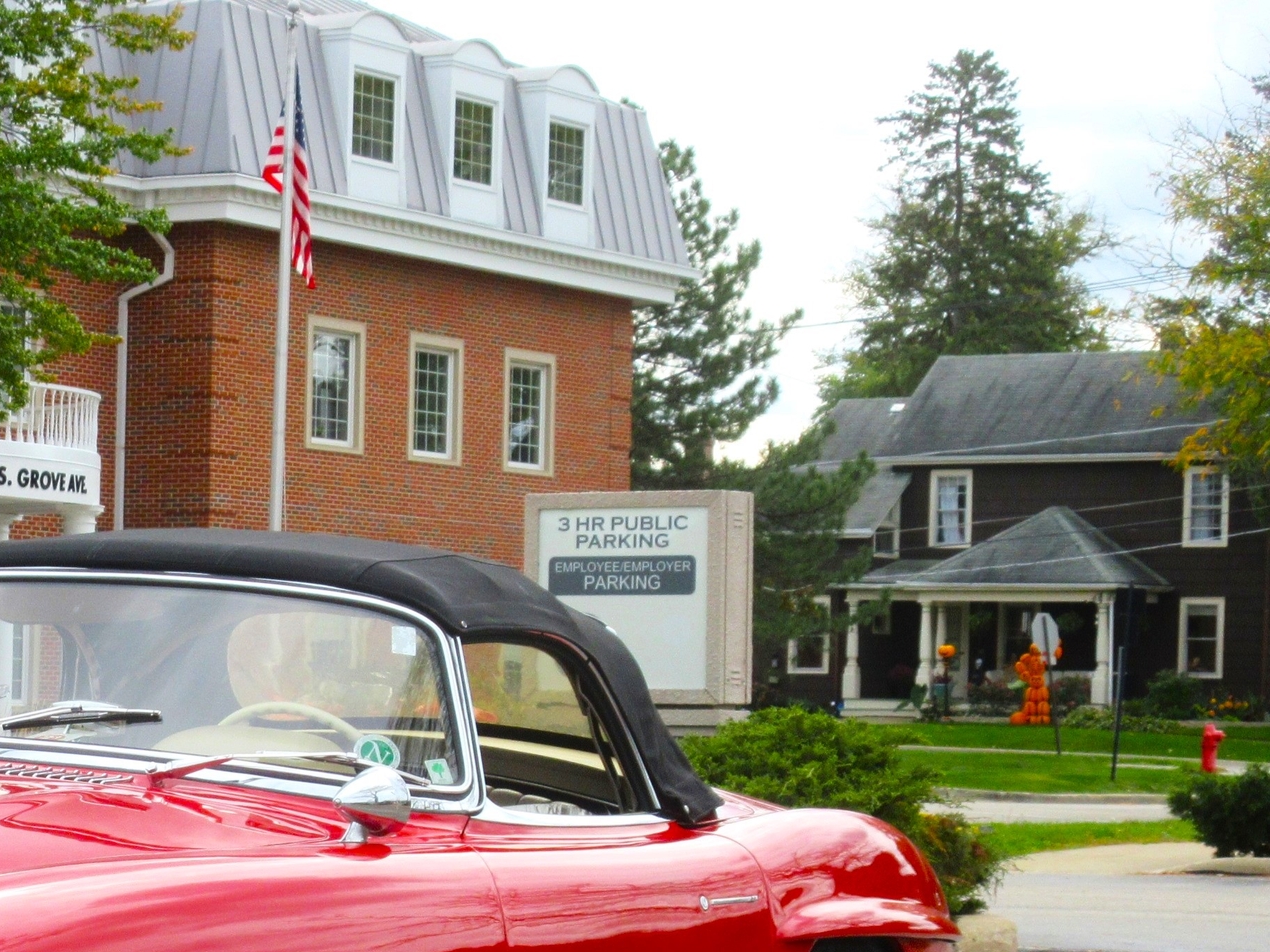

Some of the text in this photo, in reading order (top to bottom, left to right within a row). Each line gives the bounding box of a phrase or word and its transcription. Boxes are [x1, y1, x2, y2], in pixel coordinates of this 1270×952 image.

[17, 467, 66, 491] GROVE
[67, 474, 88, 494] AVE.
[558, 515, 689, 532] 3 HR PUBLIC
[575, 533, 670, 549] PARKING
[555, 560, 691, 573] EMPLOYEE/EMPLOYER
[584, 575, 661, 590] PARKING
